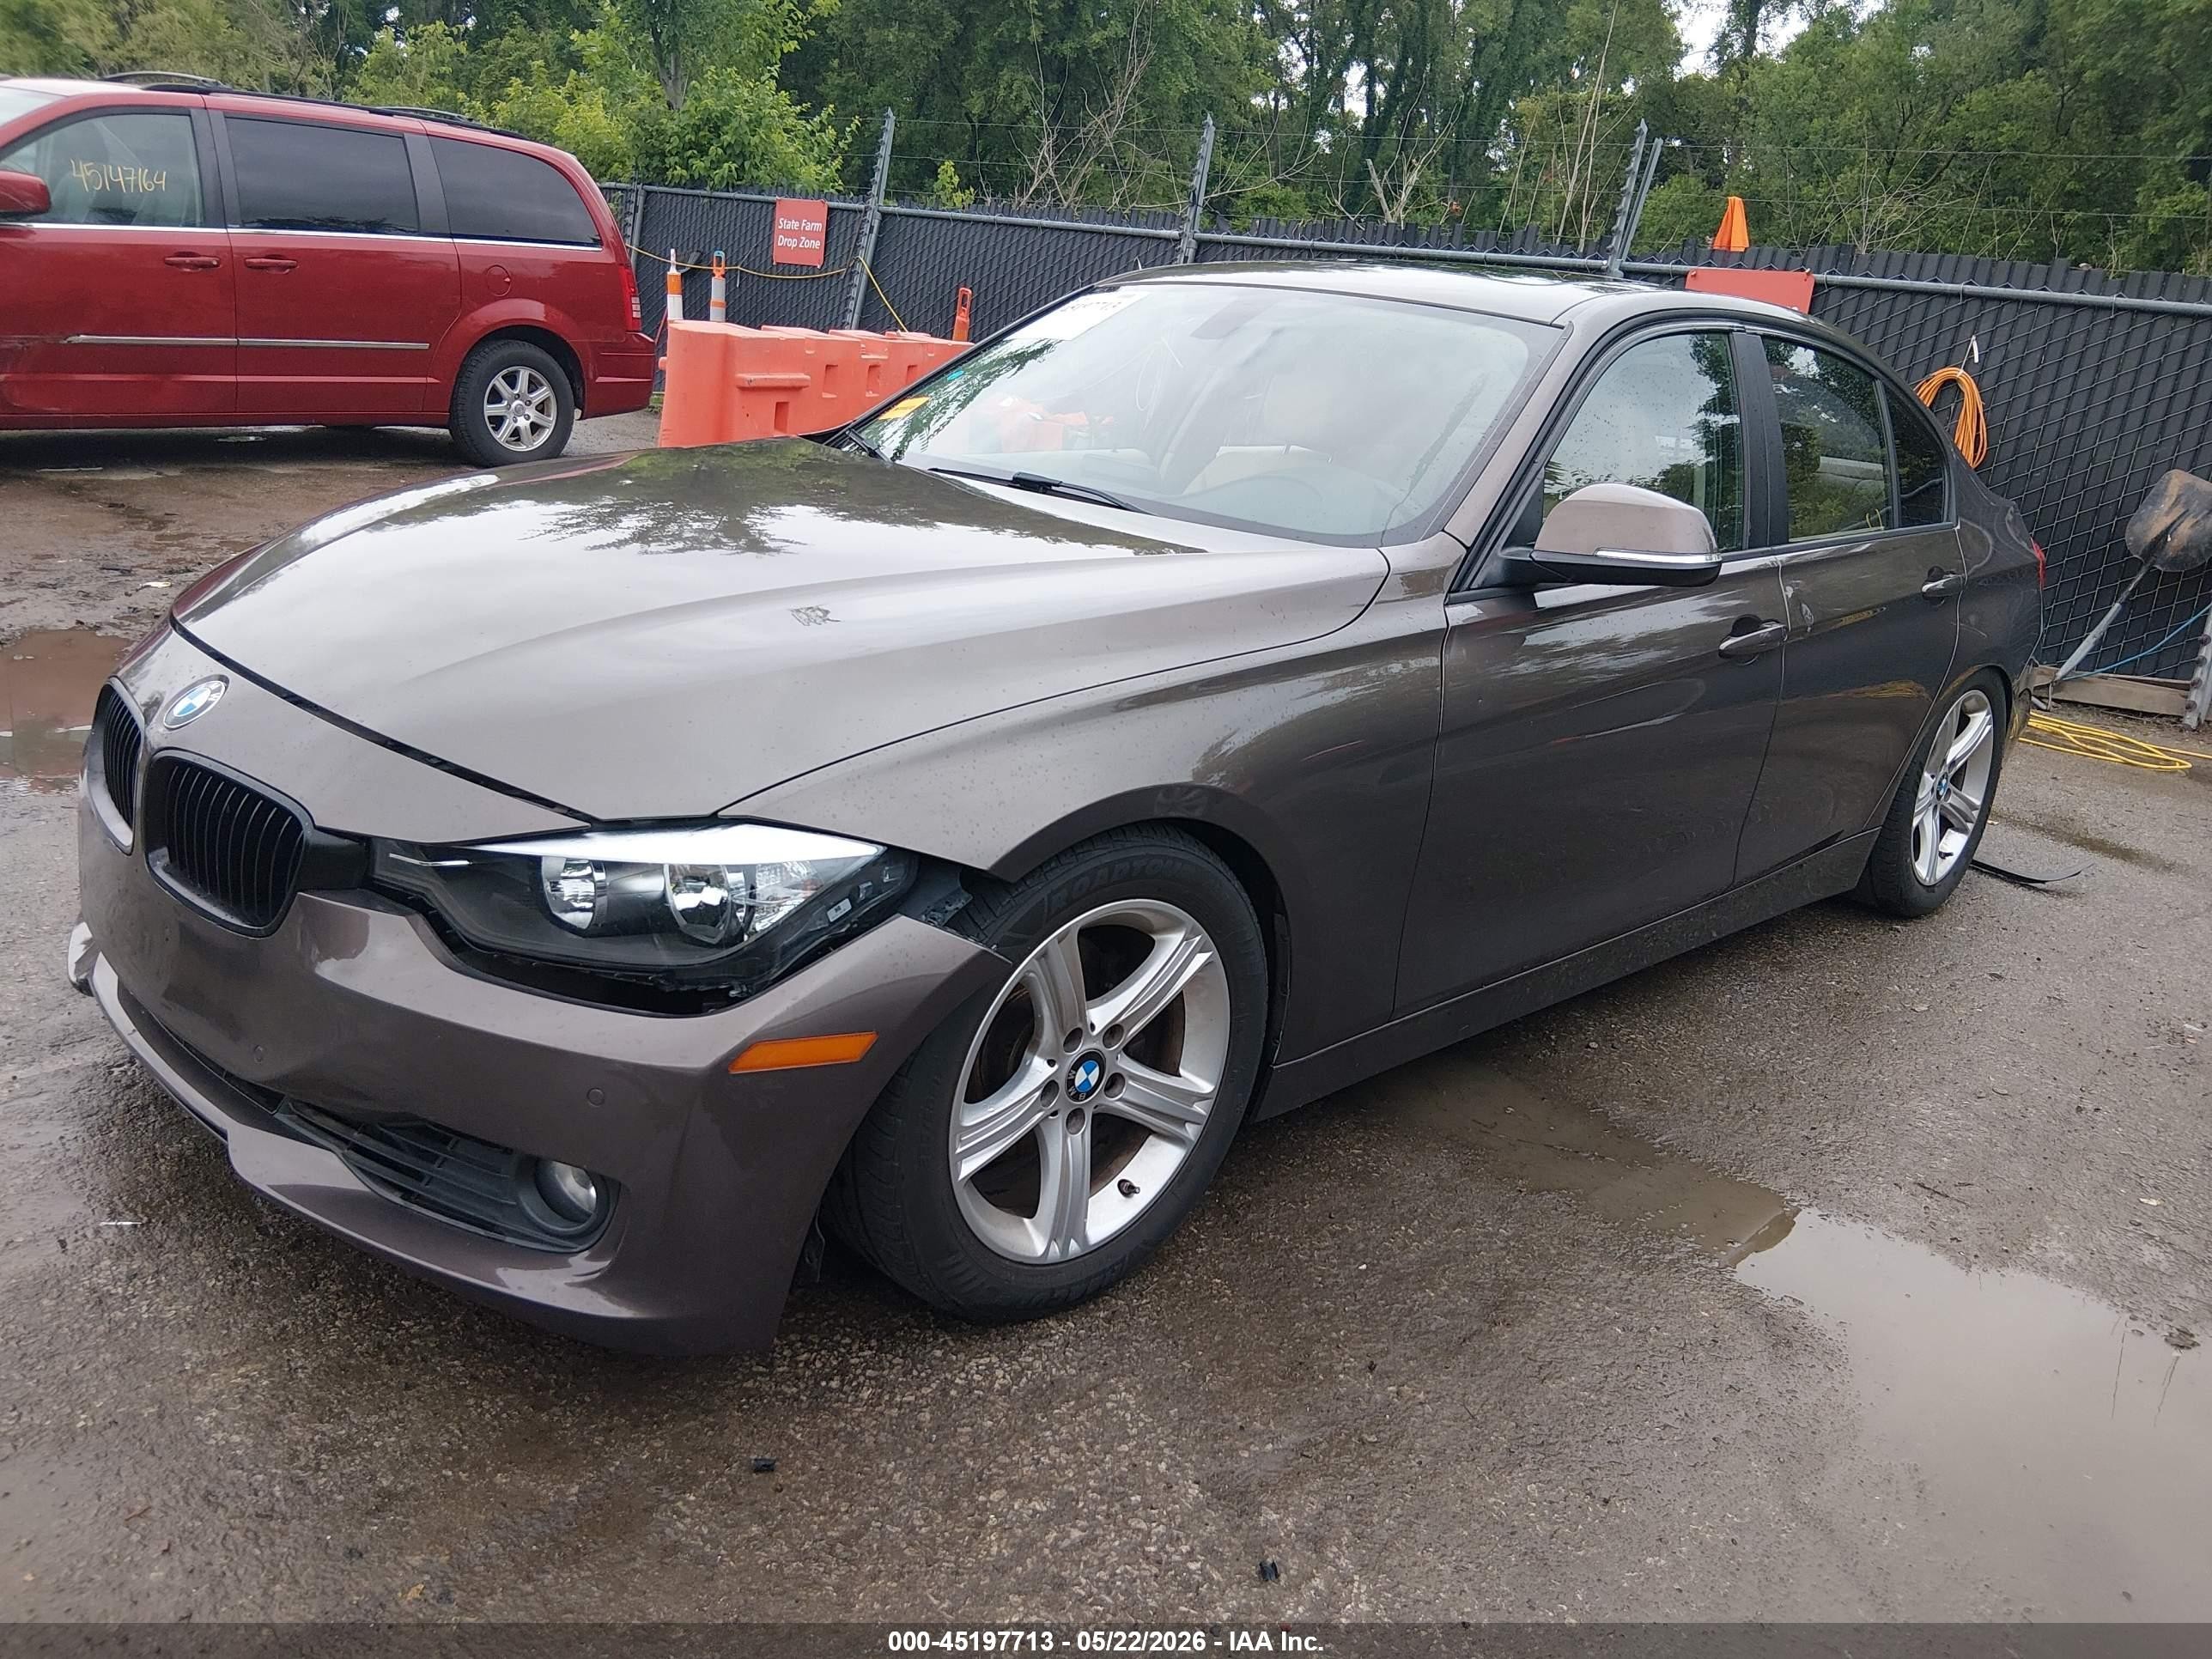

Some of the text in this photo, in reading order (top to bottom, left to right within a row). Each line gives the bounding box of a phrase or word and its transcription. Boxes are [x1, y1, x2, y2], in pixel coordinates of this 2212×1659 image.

[70, 159, 167, 192] 45147164
[778, 217, 823, 232] State Farm
[777, 234, 821, 250] Drop Zone
